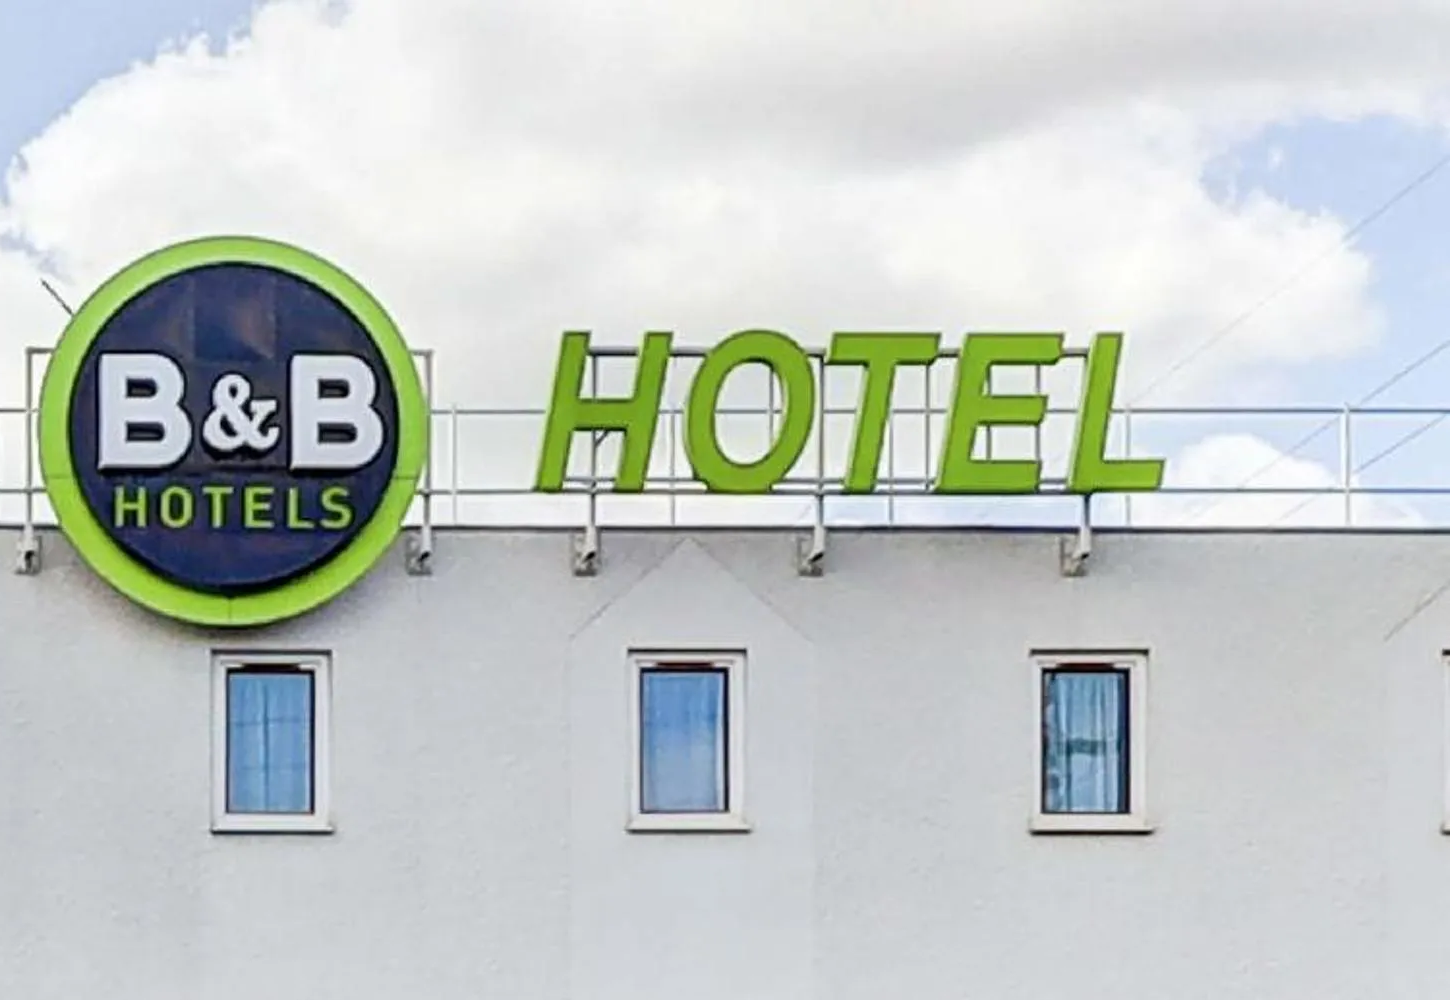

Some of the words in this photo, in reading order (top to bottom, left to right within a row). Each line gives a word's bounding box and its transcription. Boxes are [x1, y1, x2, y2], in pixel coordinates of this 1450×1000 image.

[97, 352, 384, 471] B&B
[533, 330, 1165, 493] HOTEL
[114, 486, 356, 530] HOTELS
